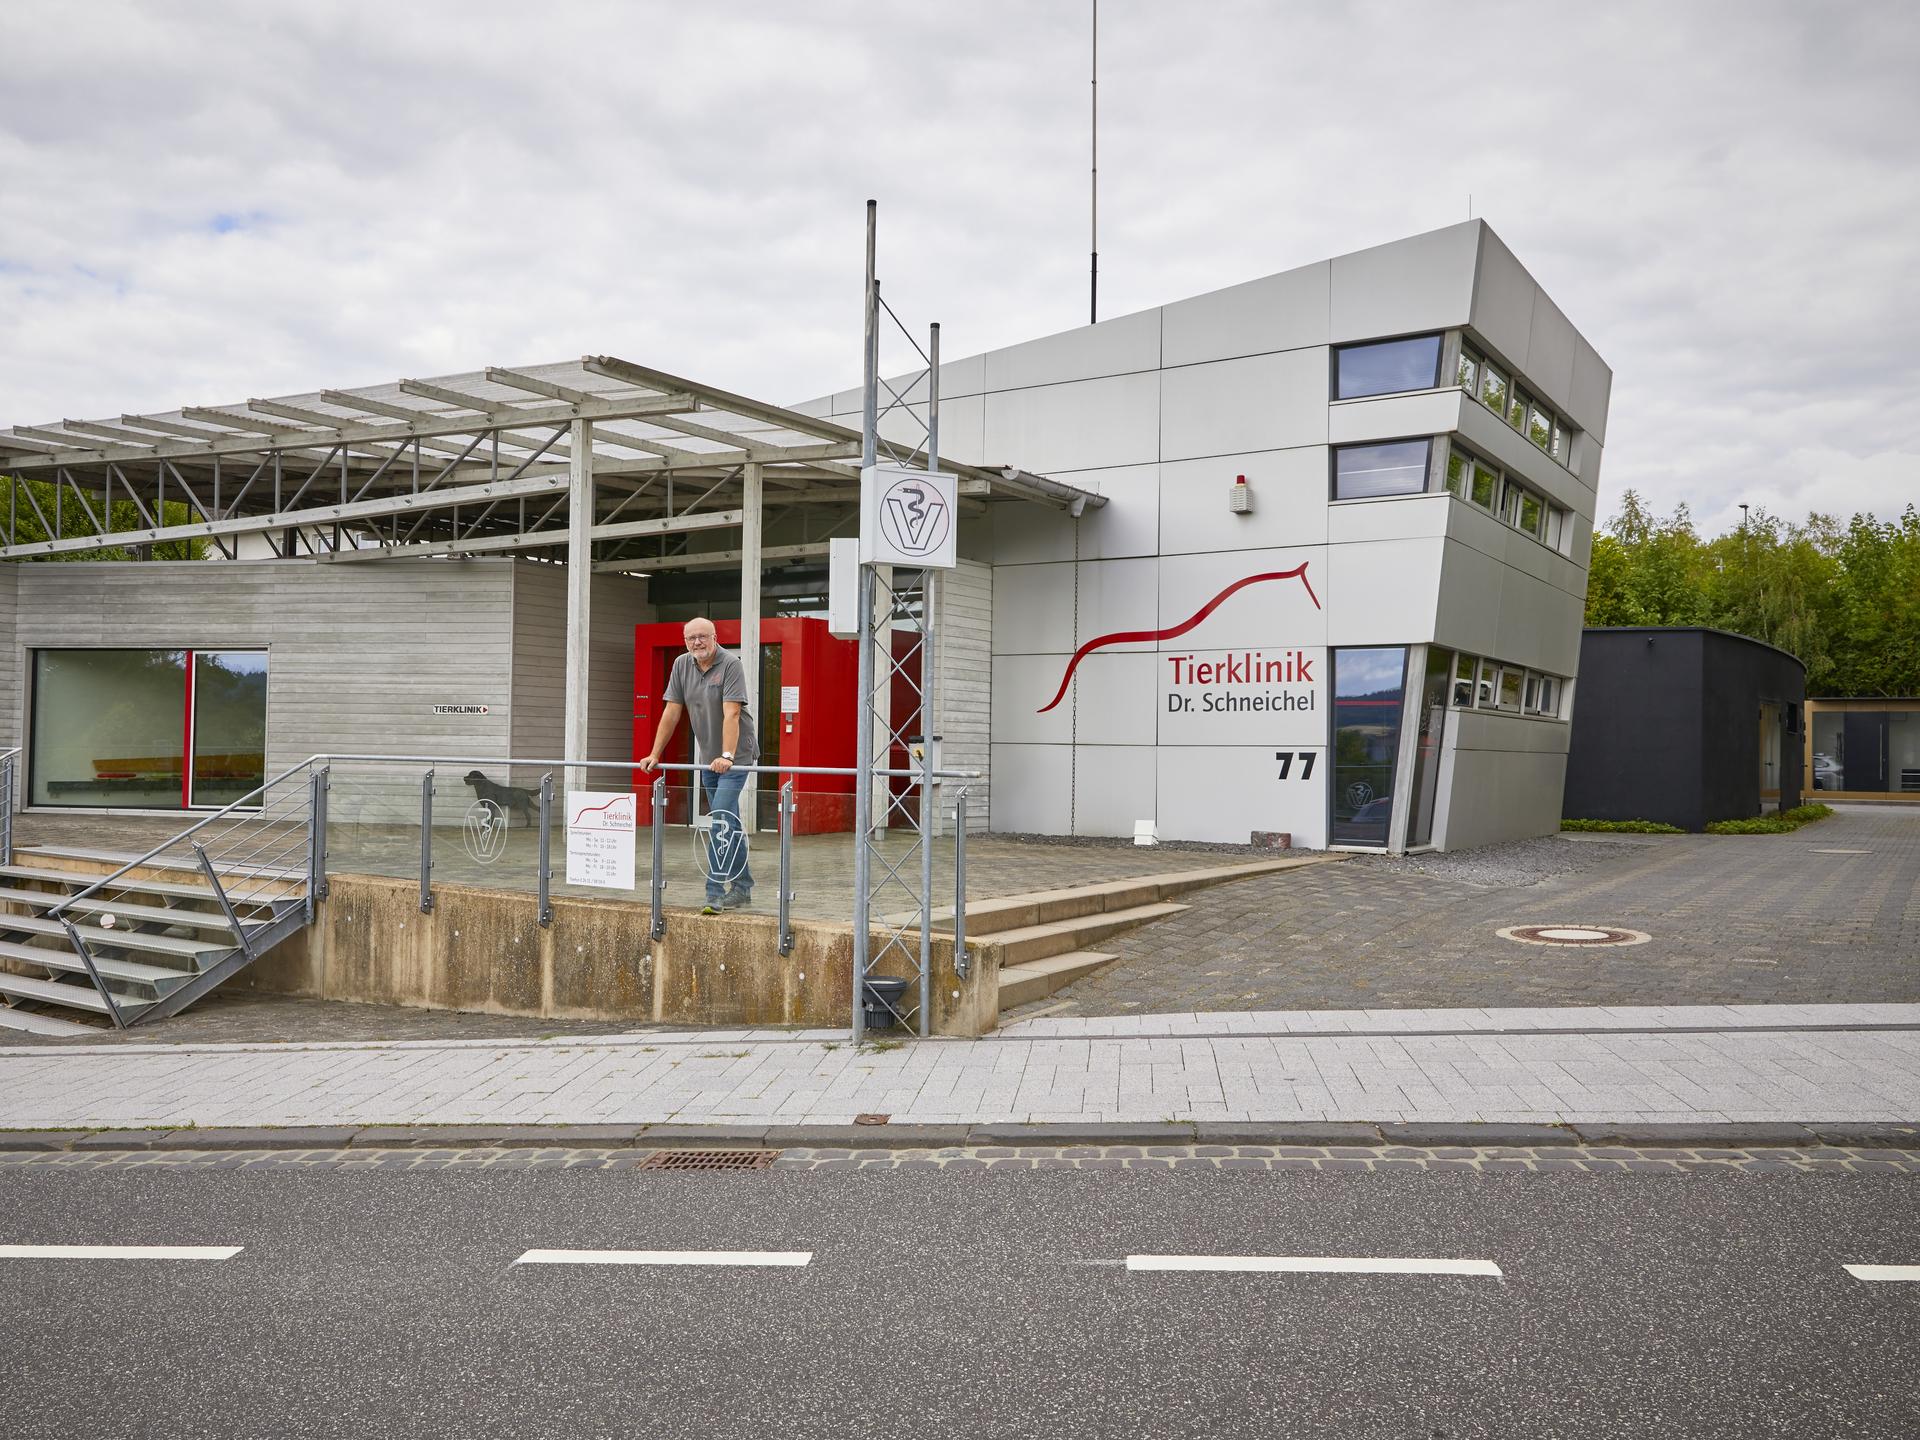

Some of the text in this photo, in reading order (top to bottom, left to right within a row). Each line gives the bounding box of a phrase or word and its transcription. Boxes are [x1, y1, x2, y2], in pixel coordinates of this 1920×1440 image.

[1168, 651, 1314, 685] Tierklinik
[434, 705, 482, 714] TIERKLINIK
[1168, 690, 1315, 713] Dr. Schneichel
[1275, 751, 1317, 780] 77
[602, 811, 632, 821] Tierklinik
